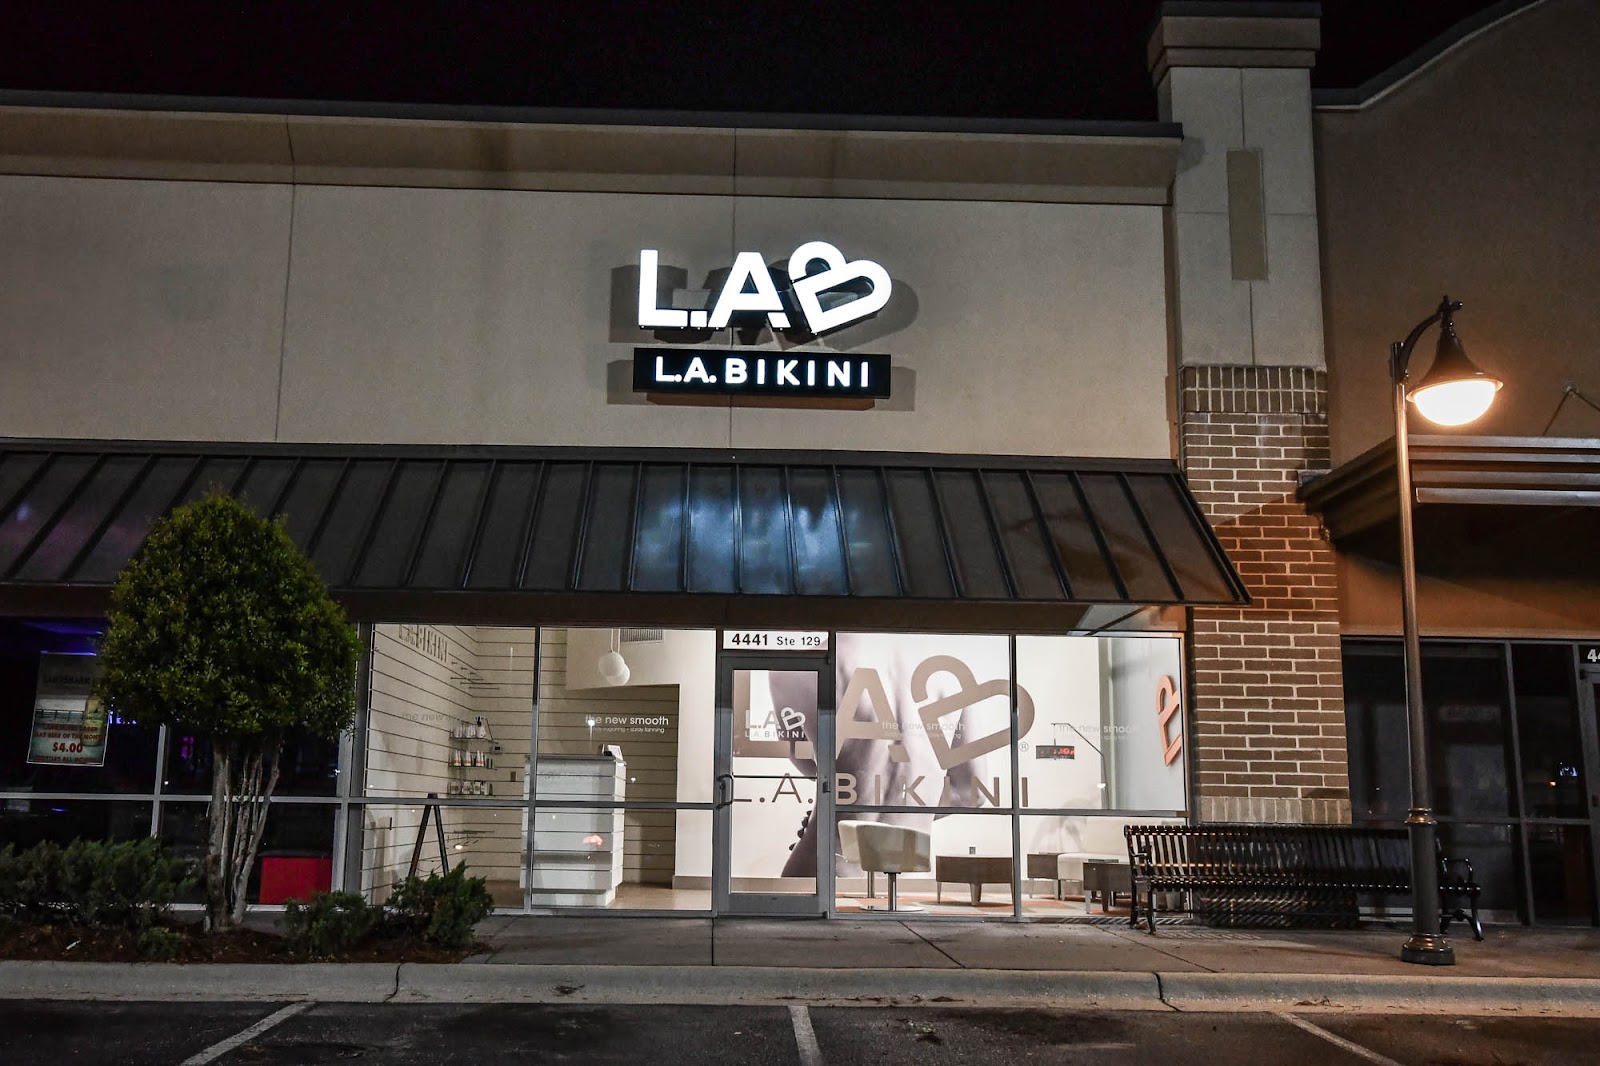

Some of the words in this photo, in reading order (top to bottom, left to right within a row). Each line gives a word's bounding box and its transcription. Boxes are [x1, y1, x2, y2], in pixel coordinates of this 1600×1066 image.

[731, 633, 768, 646] 4441
[776, 636, 796, 646] Ste
[801, 636, 821, 646] 129
[605, 716, 628, 725] new
[630, 715, 669, 727] smooth
[52, 742, 83, 753] $4.00
